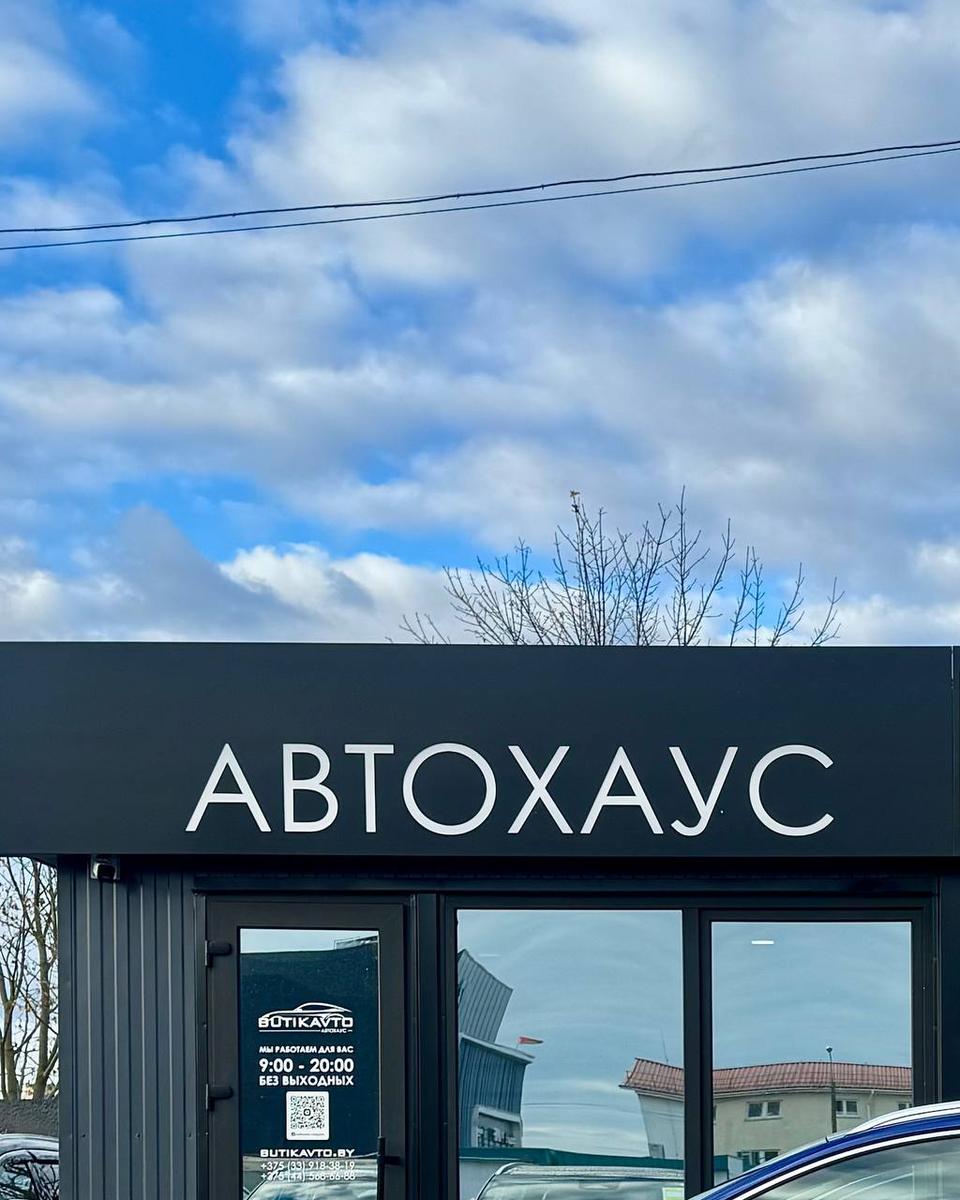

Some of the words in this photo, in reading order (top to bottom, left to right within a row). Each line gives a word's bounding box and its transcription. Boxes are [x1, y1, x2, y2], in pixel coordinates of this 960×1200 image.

[185, 742, 834, 837] АВТОХАУС
[258, 1017, 354, 1028] BUTIKAVTO
[318, 1046, 335, 1054] ДЛЯ
[259, 1058, 294, 1073] 9:00
[309, 1058, 354, 1073] 20:00
[259, 1075, 279, 1086] БЕЗ
[282, 1075, 354, 1087] ВЫХОДНЫХ
[260, 1149, 355, 1158] BUTIKAVTO.BY
[261, 1161, 285, 1170] +375
[287, 1161, 305, 1171] (33)
[308, 1161, 355, 1170] 918-38-19
